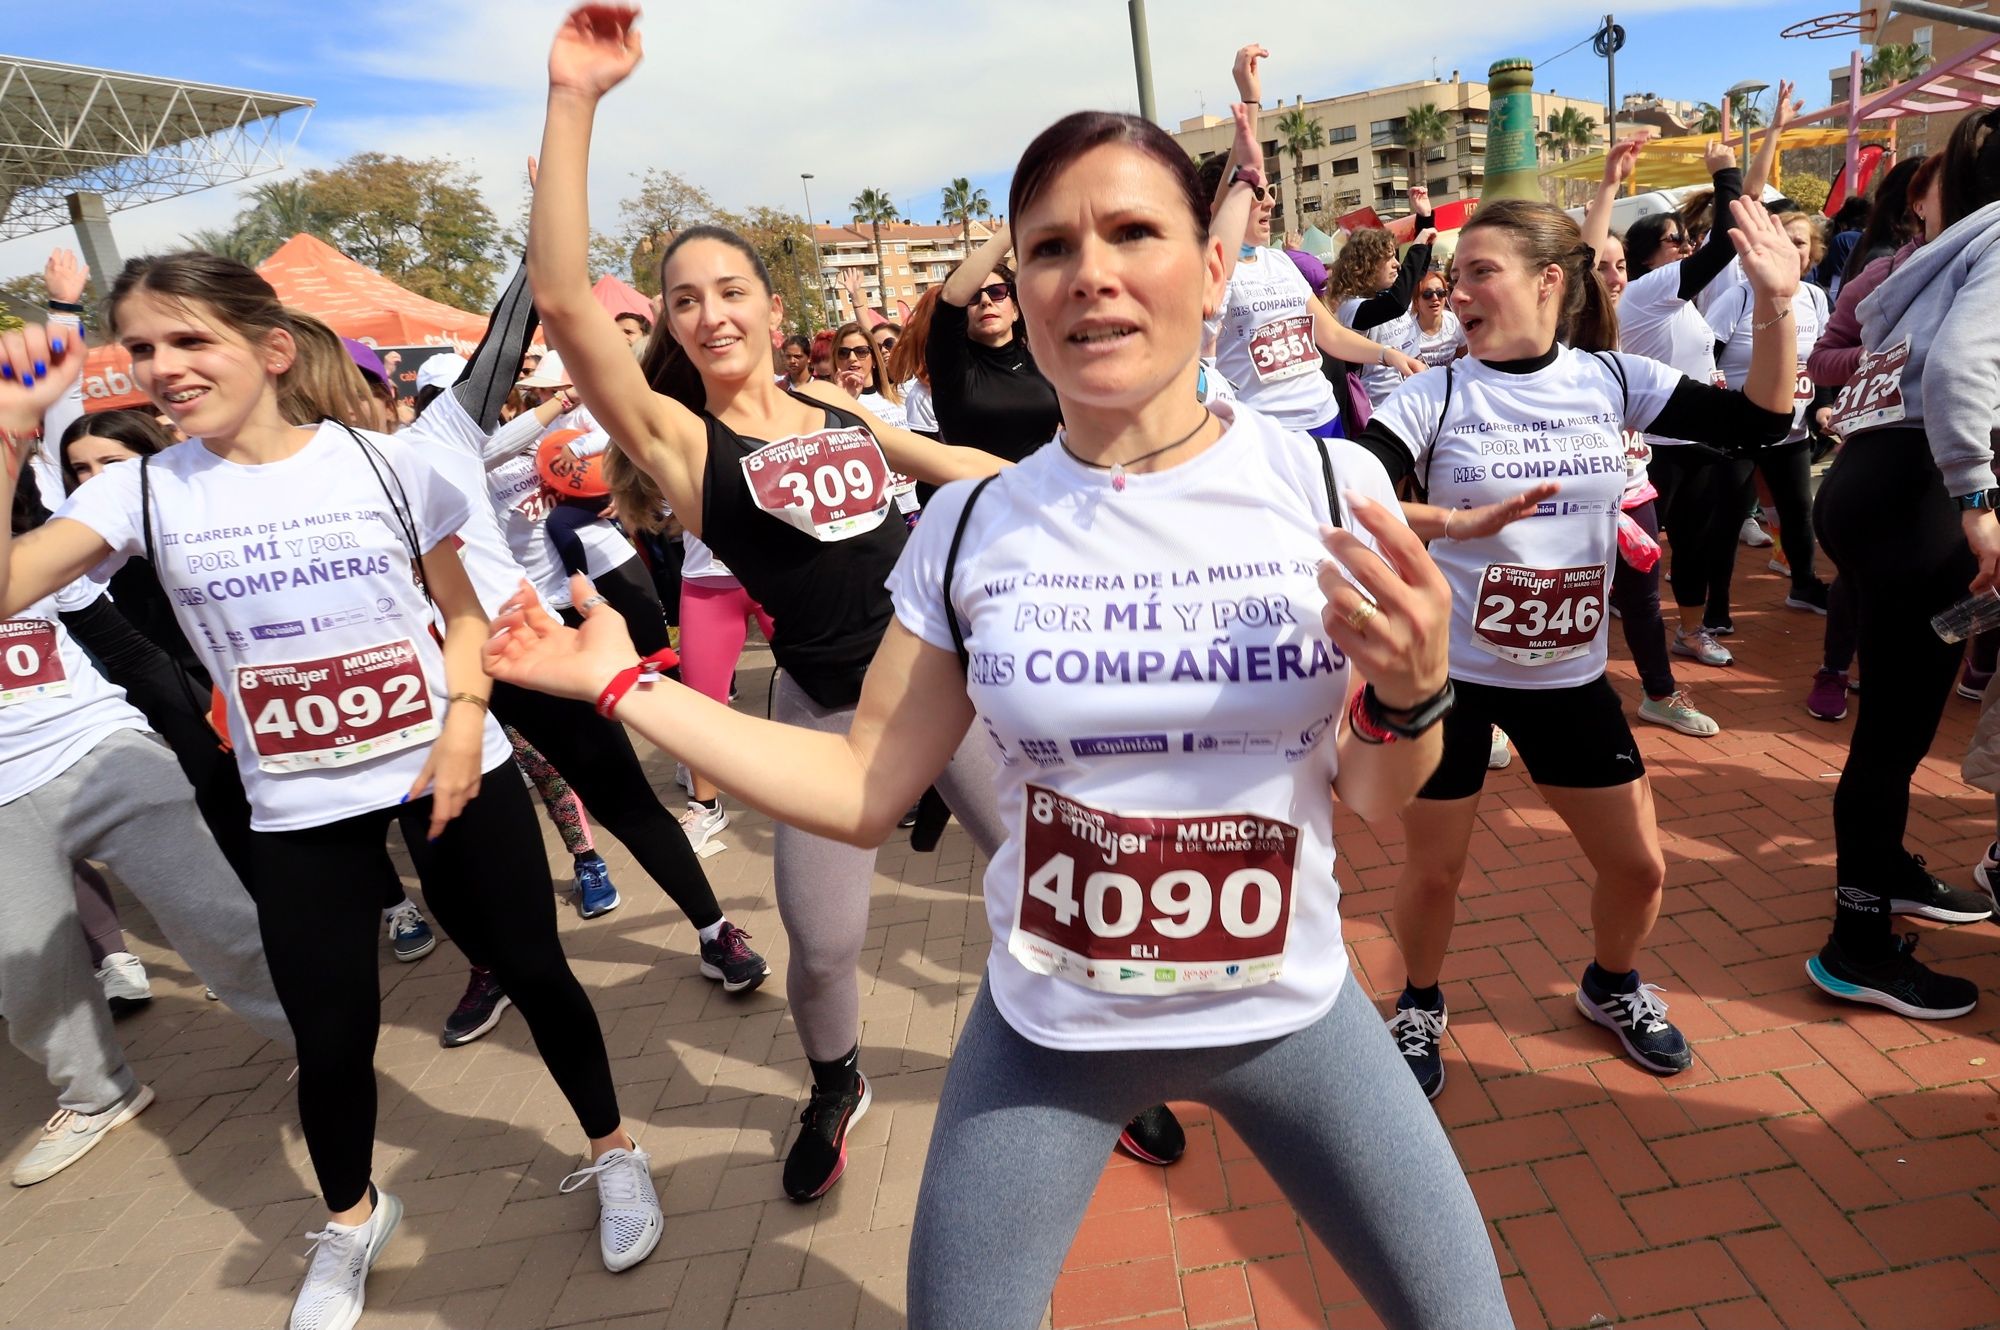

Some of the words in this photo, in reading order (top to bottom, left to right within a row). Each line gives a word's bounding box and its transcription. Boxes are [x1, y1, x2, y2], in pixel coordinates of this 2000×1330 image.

[1796, 324, 1815, 336] gual
[1253, 332, 1314, 368] 3551
[1832, 365, 1904, 416] 3125
[1454, 425, 1475, 434] VIII
[1478, 422, 1529, 433] CARRERA
[1532, 421, 1548, 432] DE
[1550, 418, 1565, 430] LA
[1568, 414, 1600, 426] MUJER
[764, 442, 796, 457] carrera
[826, 432, 866, 446] MURCIA
[842, 442, 860, 452] MARZO
[1481, 440, 1520, 456] POR
[1524, 432, 1551, 453] MÍ
[1554, 438, 1567, 452] Y
[1570, 432, 1608, 450] POR
[774, 441, 820, 466] mujer
[779, 460, 874, 510] 309
[1454, 466, 1486, 483] MIS
[830, 509, 846, 520] ISA
[1535, 504, 1556, 514] nión
[184, 526, 252, 544] CARRERA
[258, 524, 275, 534] DE
[282, 516, 300, 531] LA
[304, 512, 353, 527] MUJER
[187, 550, 240, 574] POR
[243, 534, 281, 564] MÍ
[286, 539, 304, 558] Y
[308, 531, 360, 554] POR
[207, 555, 390, 602] COMPAÑERAS
[1023, 572, 1124, 590] CARRERA
[1134, 572, 1163, 590] DE
[1172, 570, 1200, 589] LA
[1208, 562, 1284, 582] MUJER
[1506, 568, 1536, 578] carrera
[1564, 570, 1600, 582] MURCIA
[1512, 576, 1556, 596] mujer
[1014, 602, 1092, 633] POR
[1104, 592, 1162, 632] MÍ
[1173, 603, 1202, 632] Y
[1212, 593, 1298, 629] POR
[1478, 595, 1600, 637] 2346
[342, 646, 408, 670] MURCIA
[971, 653, 1014, 686] MIS
[1025, 636, 1346, 685] COMPAÑERAS
[271, 668, 330, 692] mujer
[254, 674, 426, 739] 4092
[335, 735, 356, 745] ELI
[1071, 815, 1153, 866] mujer
[1177, 819, 1284, 842] MURCIA
[1186, 842, 1202, 853] DE
[1206, 840, 1252, 852] MARZO
[1028, 852, 1282, 939] 4090
[1839, 899, 1880, 914] umbro
[1130, 944, 1159, 959] ELI
